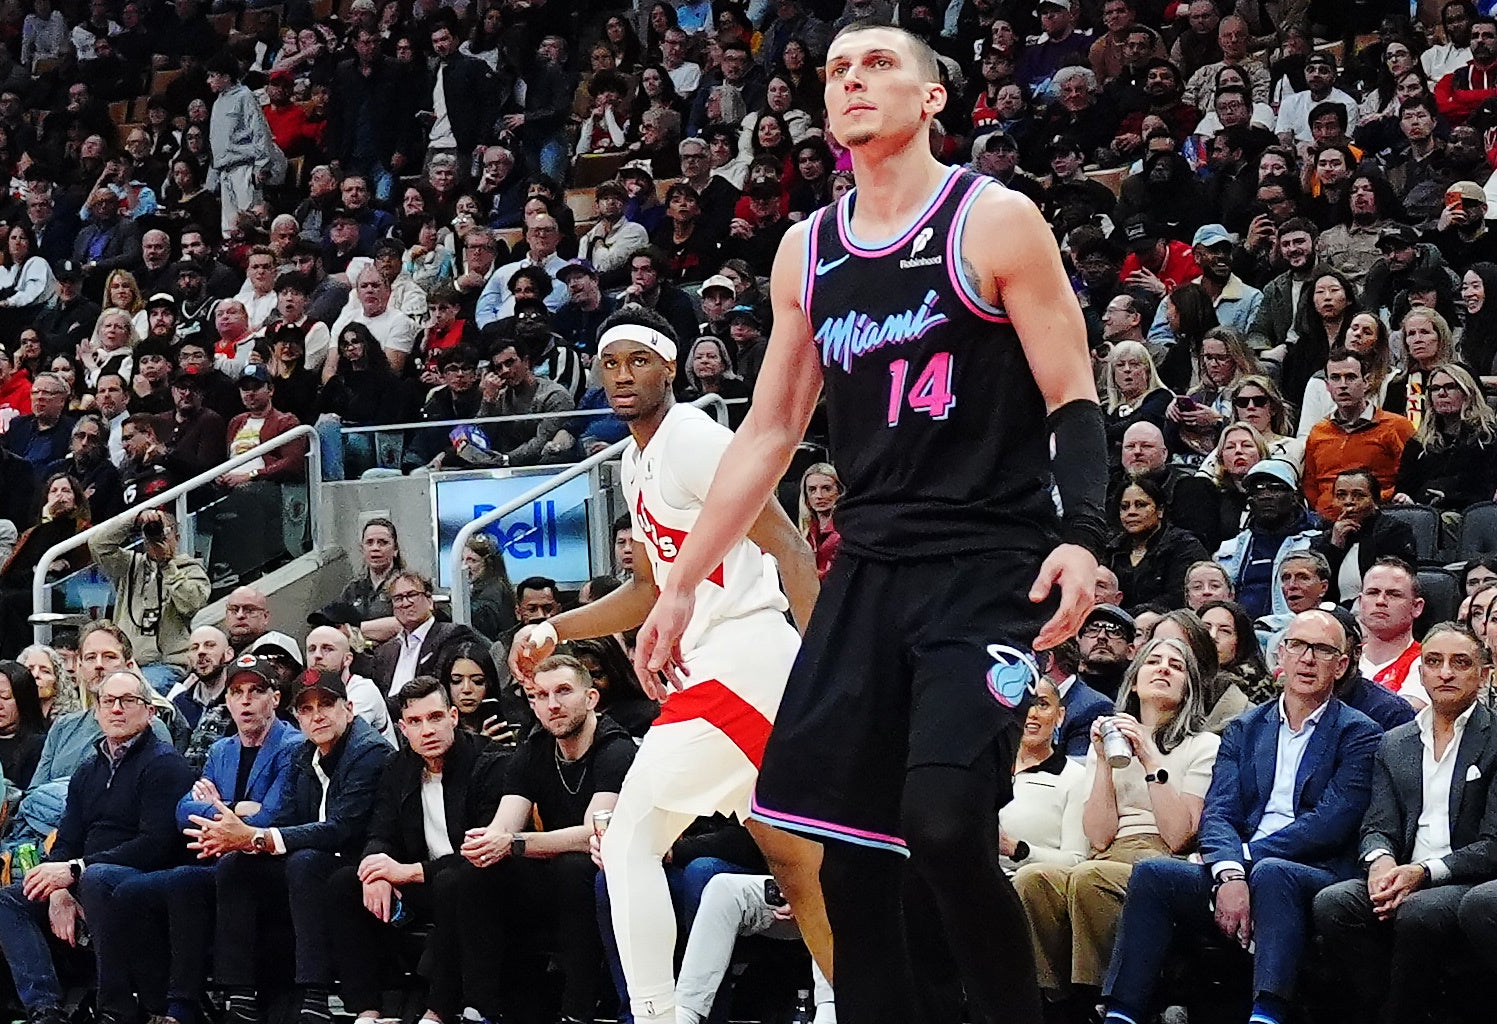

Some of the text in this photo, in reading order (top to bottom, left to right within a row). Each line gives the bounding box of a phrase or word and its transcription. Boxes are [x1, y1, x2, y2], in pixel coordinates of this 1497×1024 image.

[814, 289, 950, 375] Miami
[887, 351, 957, 428] 14
[473, 499, 557, 559] Bell
